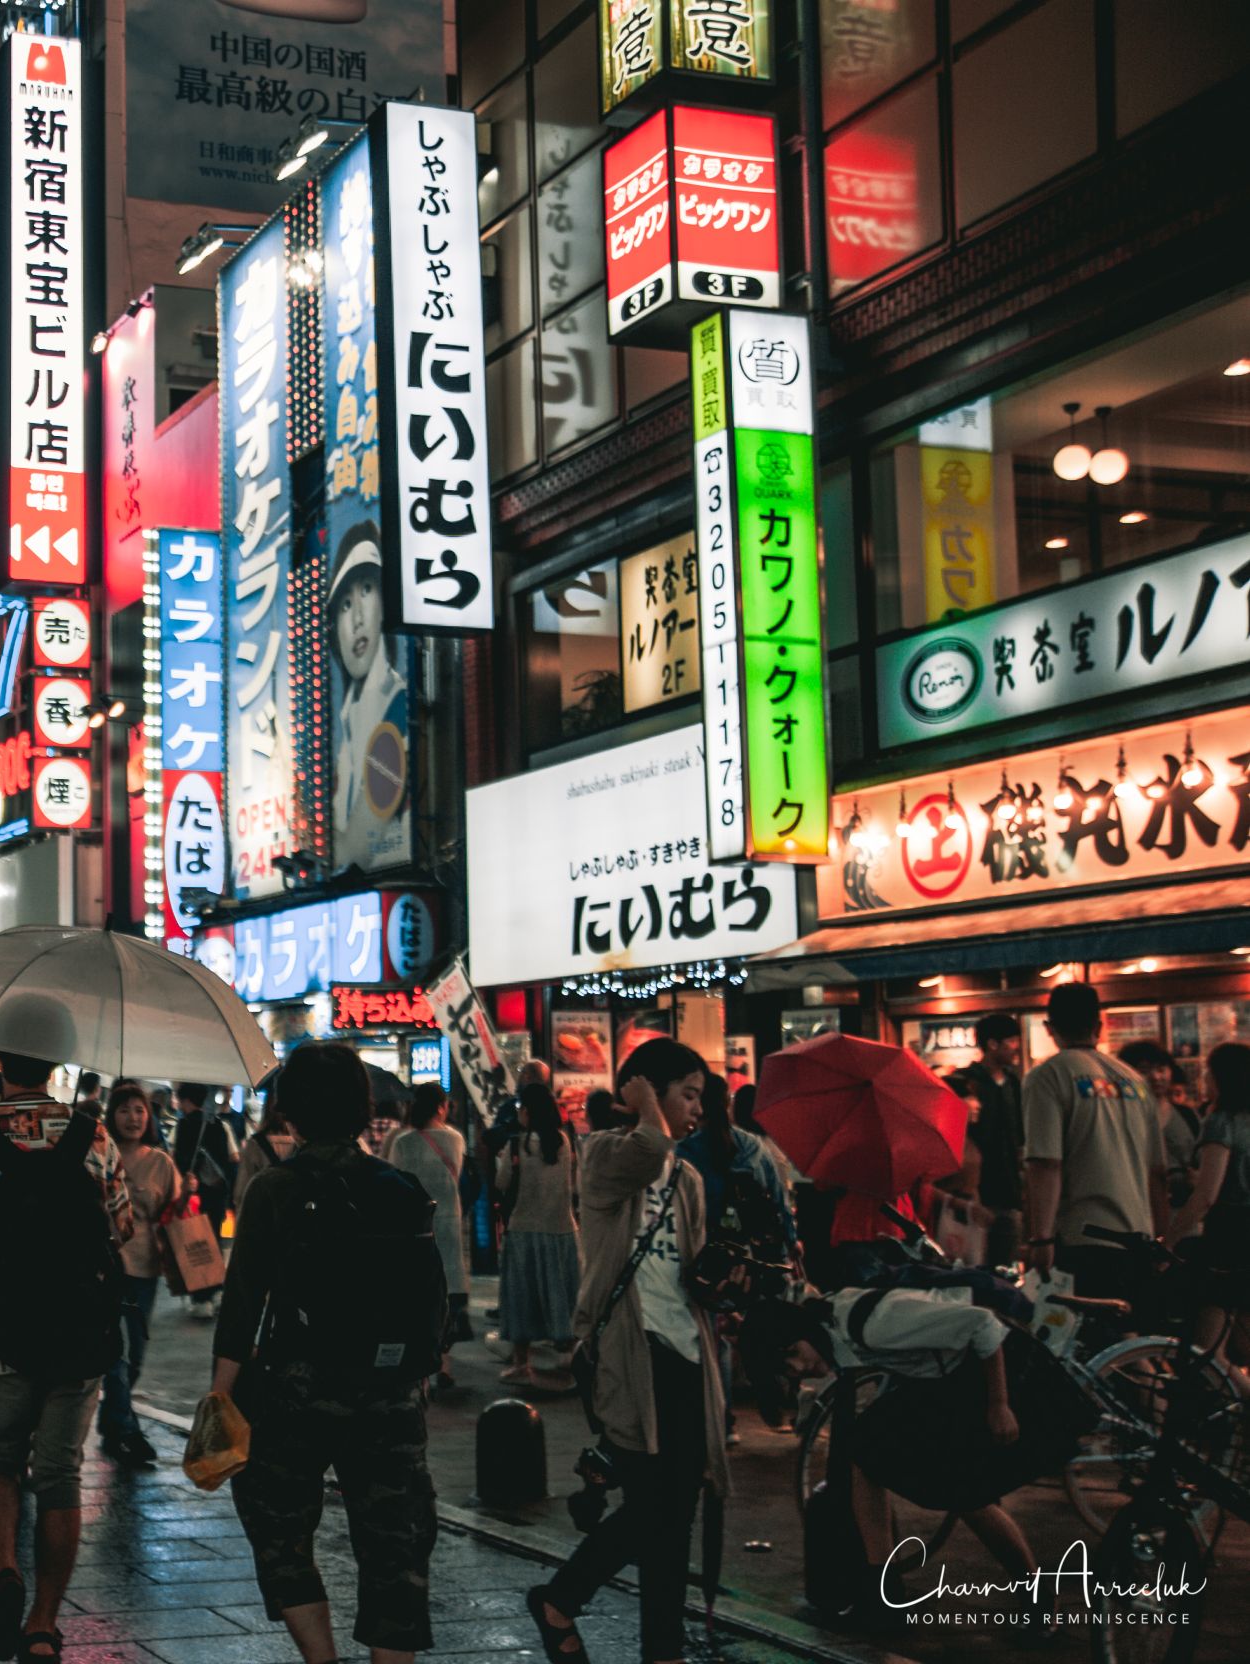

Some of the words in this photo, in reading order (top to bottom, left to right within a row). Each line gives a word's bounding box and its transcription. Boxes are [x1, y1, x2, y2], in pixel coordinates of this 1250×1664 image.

[209, 30, 367, 82] 中国の国酒
[683, 154, 764, 184] カラオケ
[417, 118, 456, 321] しゃぶしゃぶ
[610, 200, 669, 261] ビックワン
[679, 193, 771, 233] ビックワン
[23, 105, 70, 466] 新宿東宝ビル店
[627, 282, 656, 316] 3F
[707, 272, 748, 298] 3F
[407, 330, 482, 610] にいむら
[233, 256, 286, 791] カラオケランド
[165, 535, 221, 770] カラオケ
[993, 611, 1097, 698] 喫茶室
[1115, 558, 1250, 672] ルノ
[661, 658, 686, 696] 2F
[758, 507, 805, 838] カワノ・クォーク
[175, 795, 214, 876] たば
[235, 795, 287, 838] OPEN
[568, 836, 701, 882] しゃぶしゃぶ・すきやき
[980, 752, 1250, 886] 磯丸水
[235, 903, 381, 994] カラオケ
[571, 867, 773, 957] にいむら
